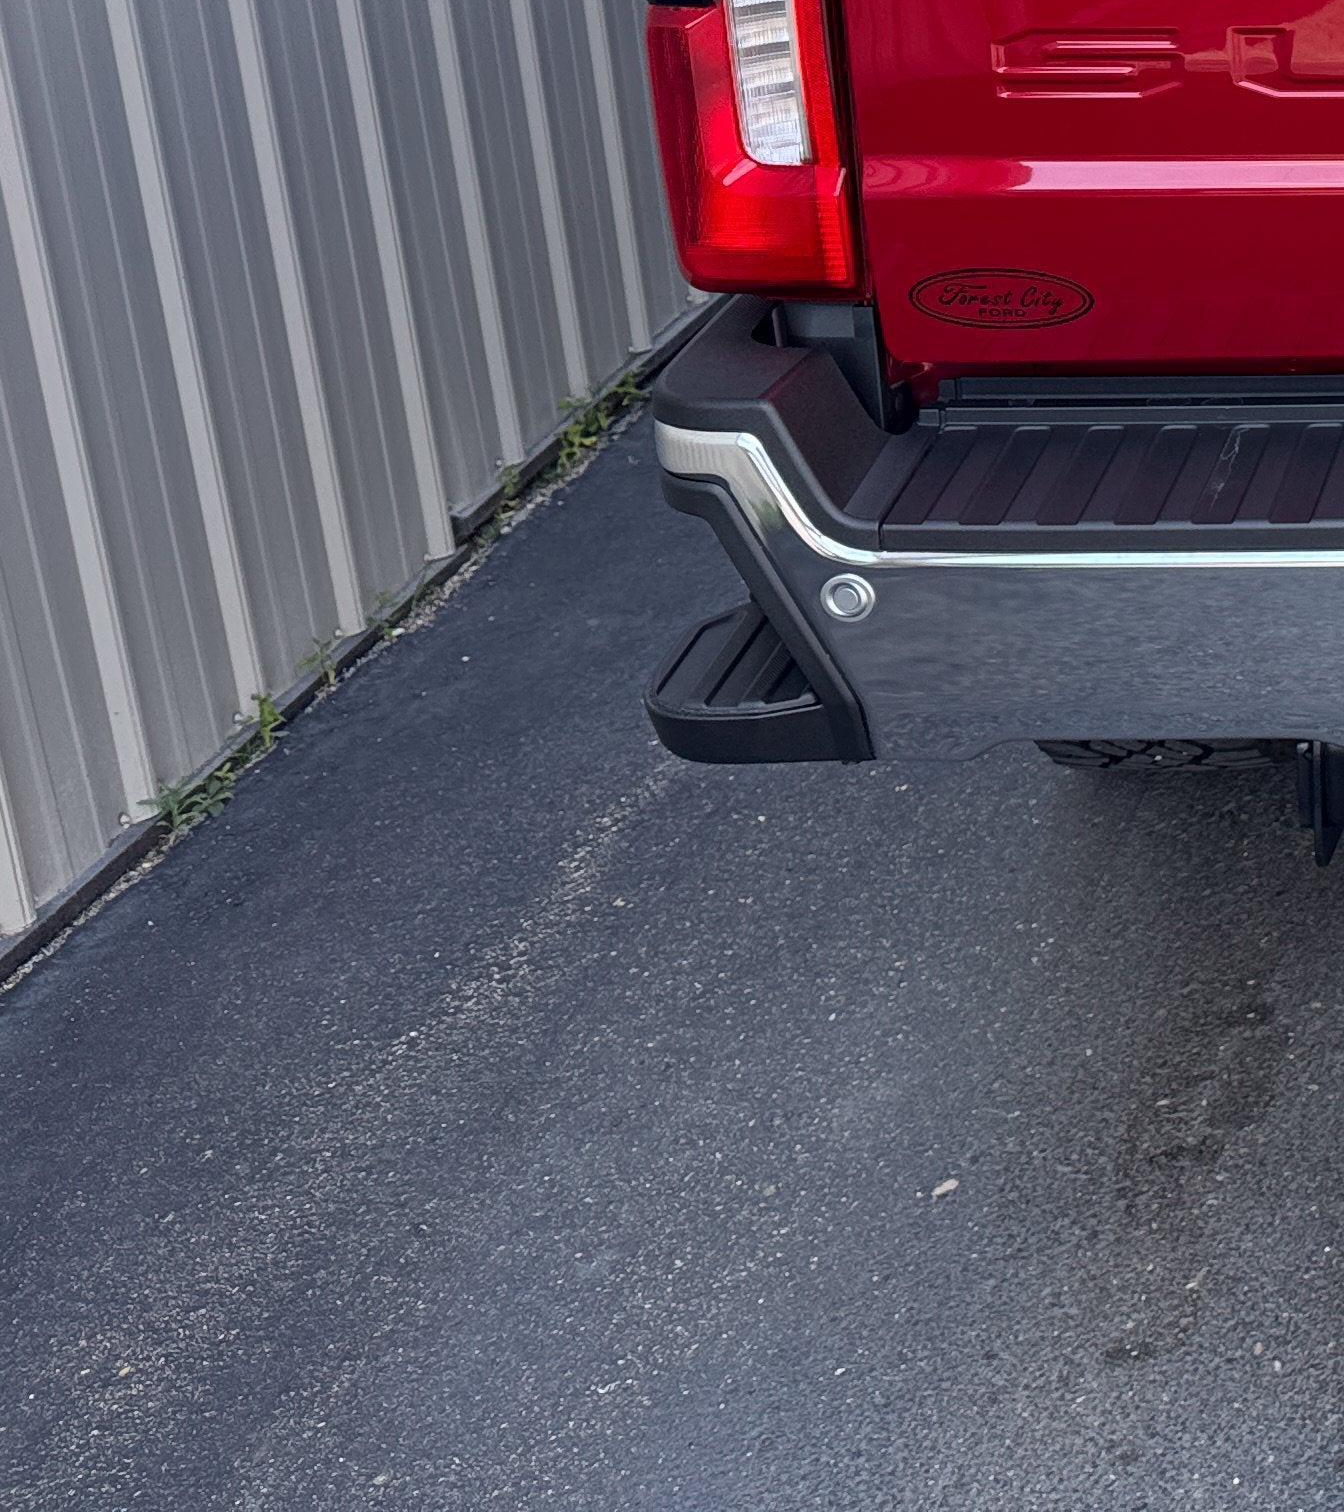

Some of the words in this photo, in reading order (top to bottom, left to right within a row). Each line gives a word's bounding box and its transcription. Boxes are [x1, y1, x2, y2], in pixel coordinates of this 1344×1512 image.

[939, 283, 1013, 305] Forest
[1021, 286, 1063, 315] City
[978, 307, 1027, 318] FORD
